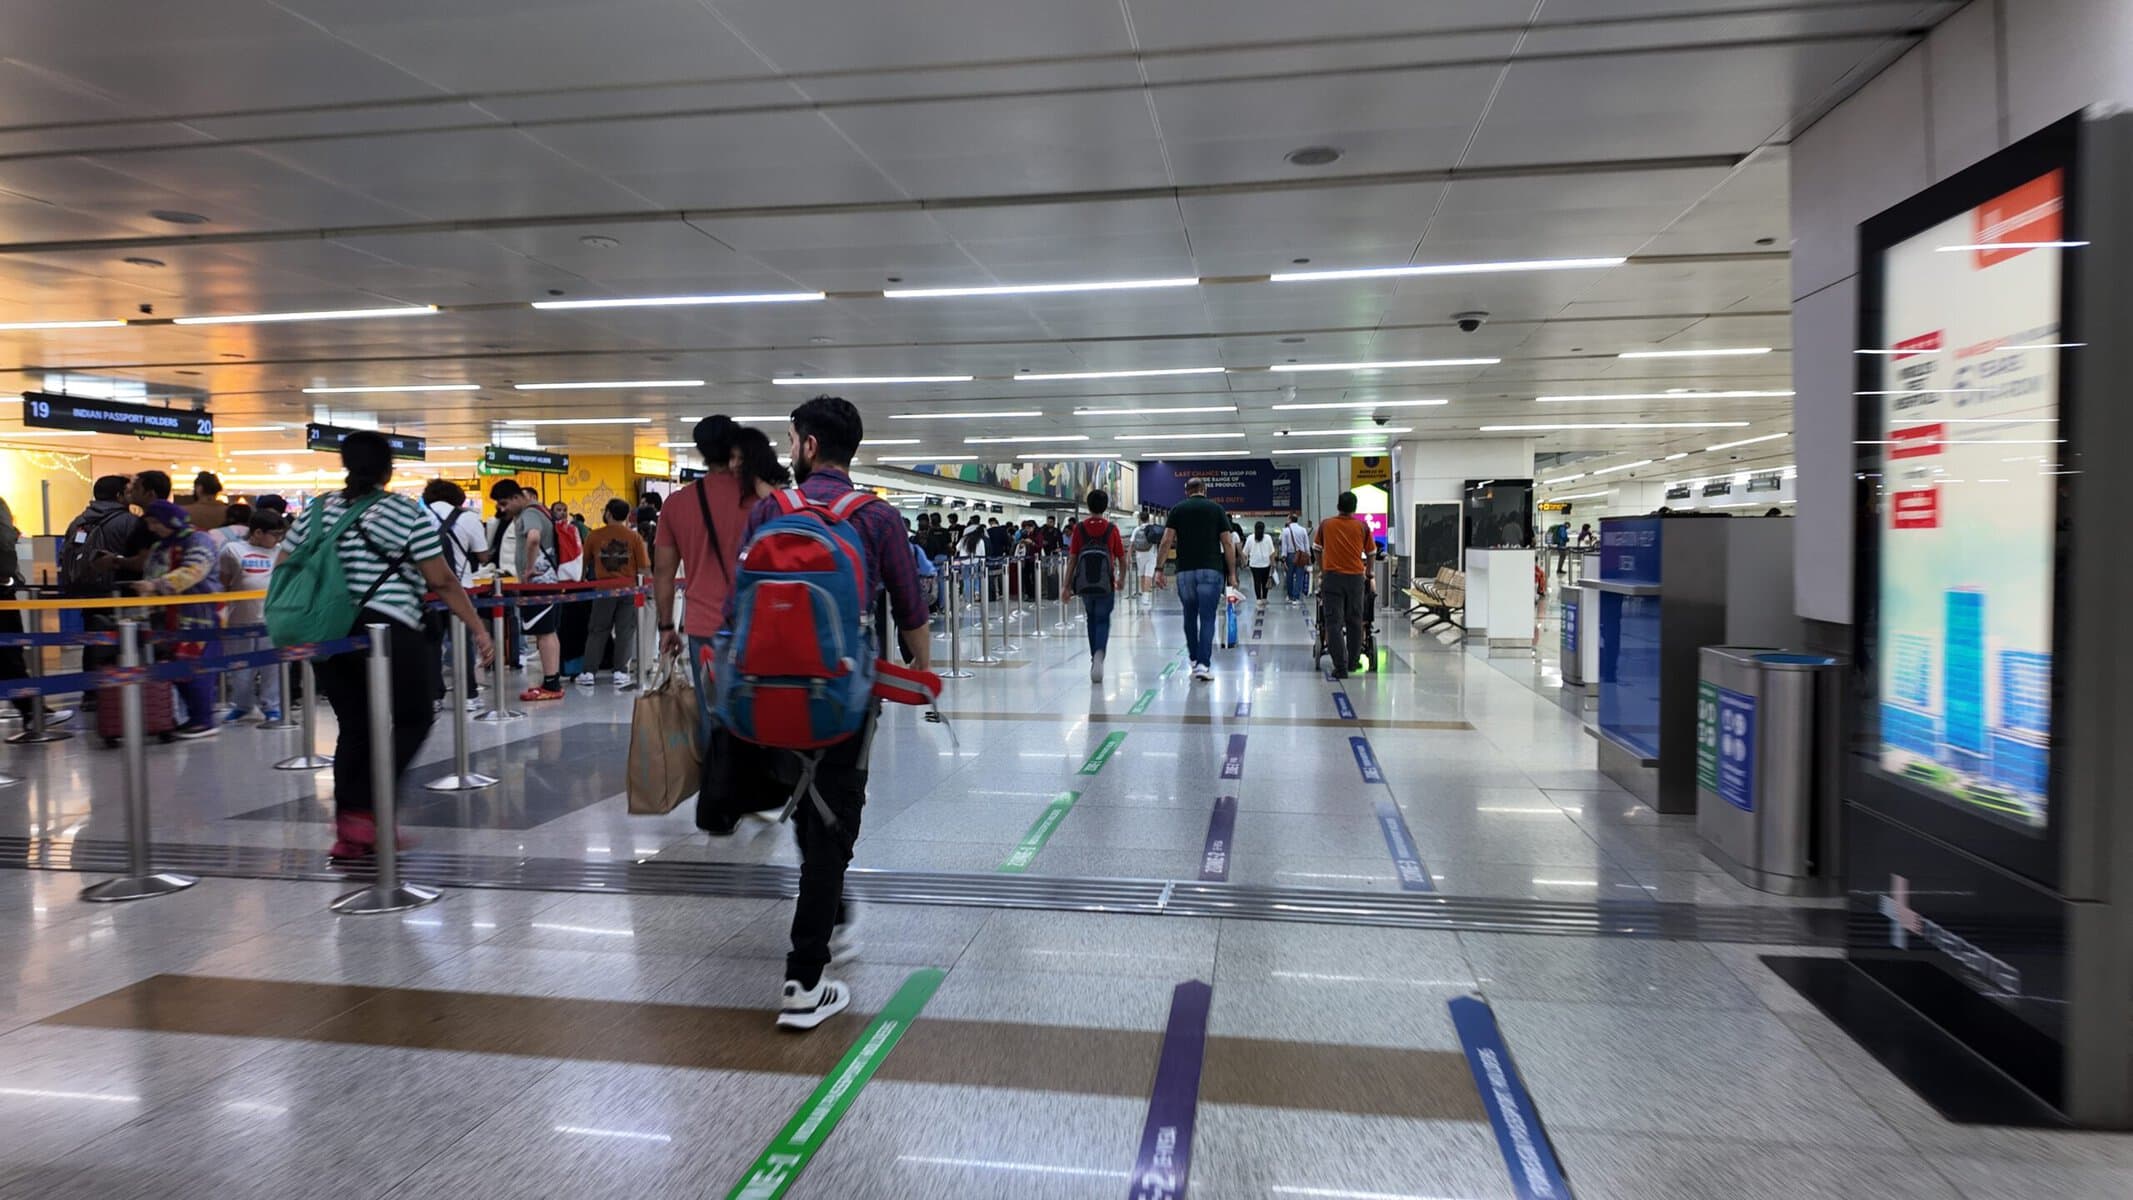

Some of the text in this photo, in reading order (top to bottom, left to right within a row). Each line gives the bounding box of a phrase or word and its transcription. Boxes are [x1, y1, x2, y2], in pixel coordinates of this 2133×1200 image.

[30, 401, 50, 418] 19
[72, 408, 179, 427] INDIAN PASSPORT HOLDERS
[197, 419, 212, 435] 20
